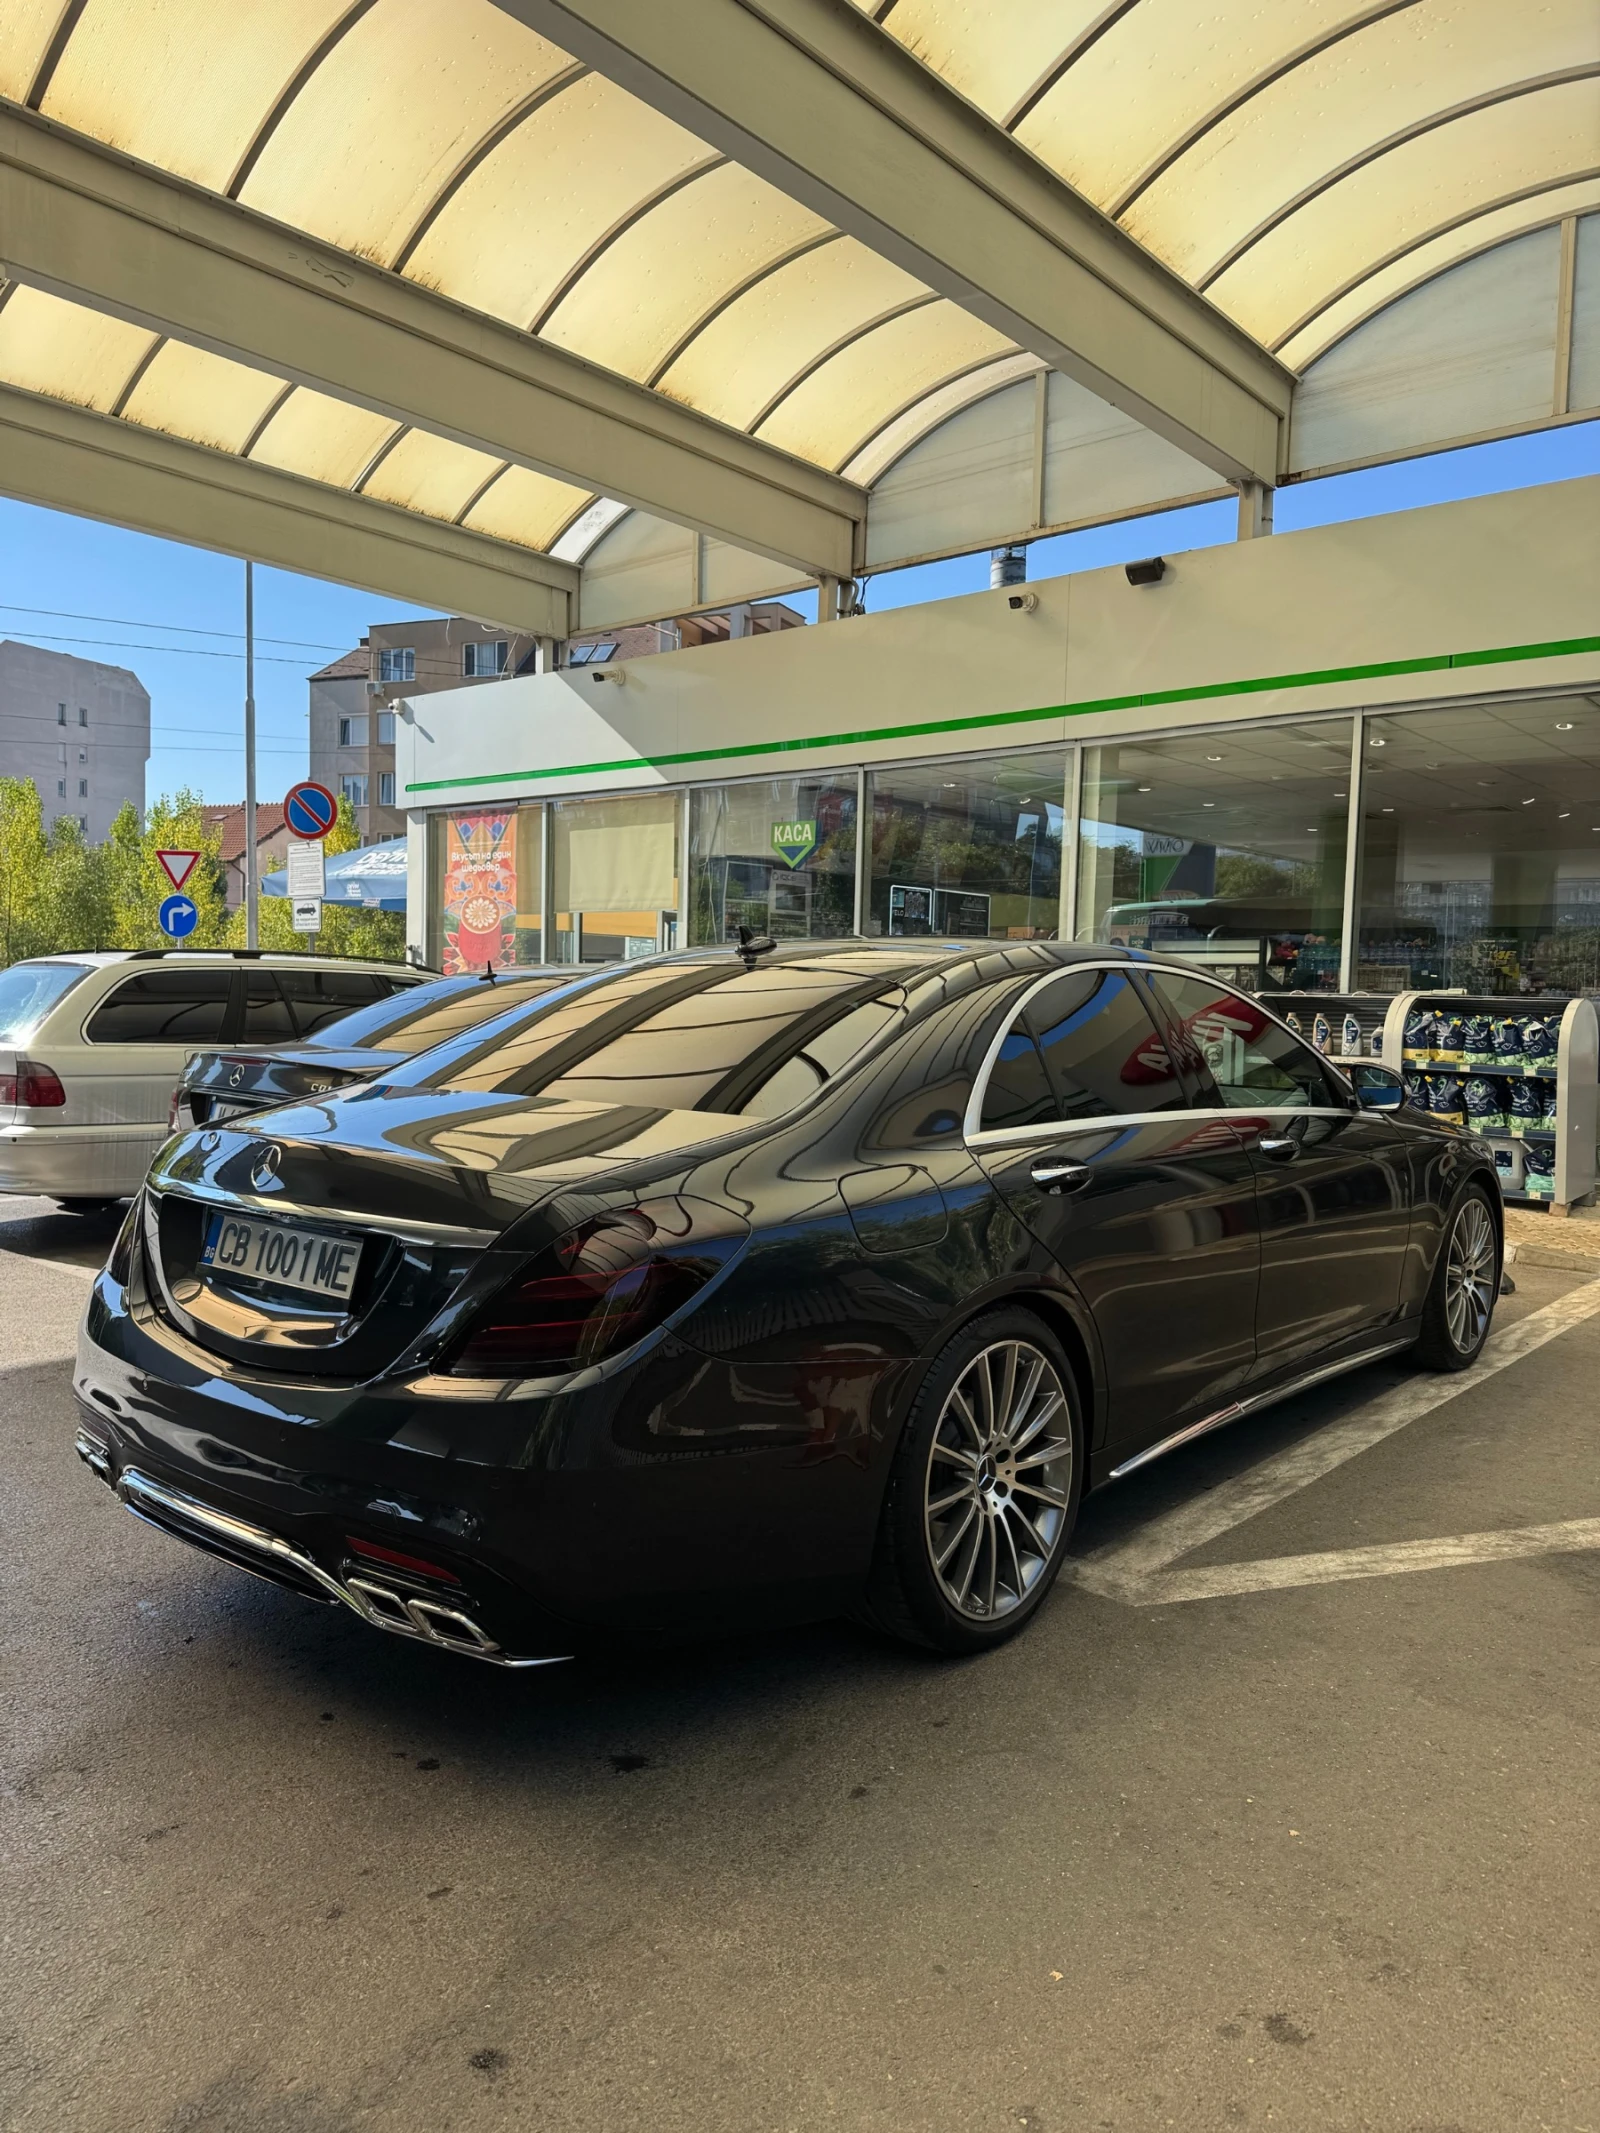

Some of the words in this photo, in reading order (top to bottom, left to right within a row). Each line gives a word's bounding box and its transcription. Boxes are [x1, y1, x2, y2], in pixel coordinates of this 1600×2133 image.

[774, 823, 813, 843] КАСА
[492, 851, 512, 861] един
[204, 1245, 215, 1259] BG
